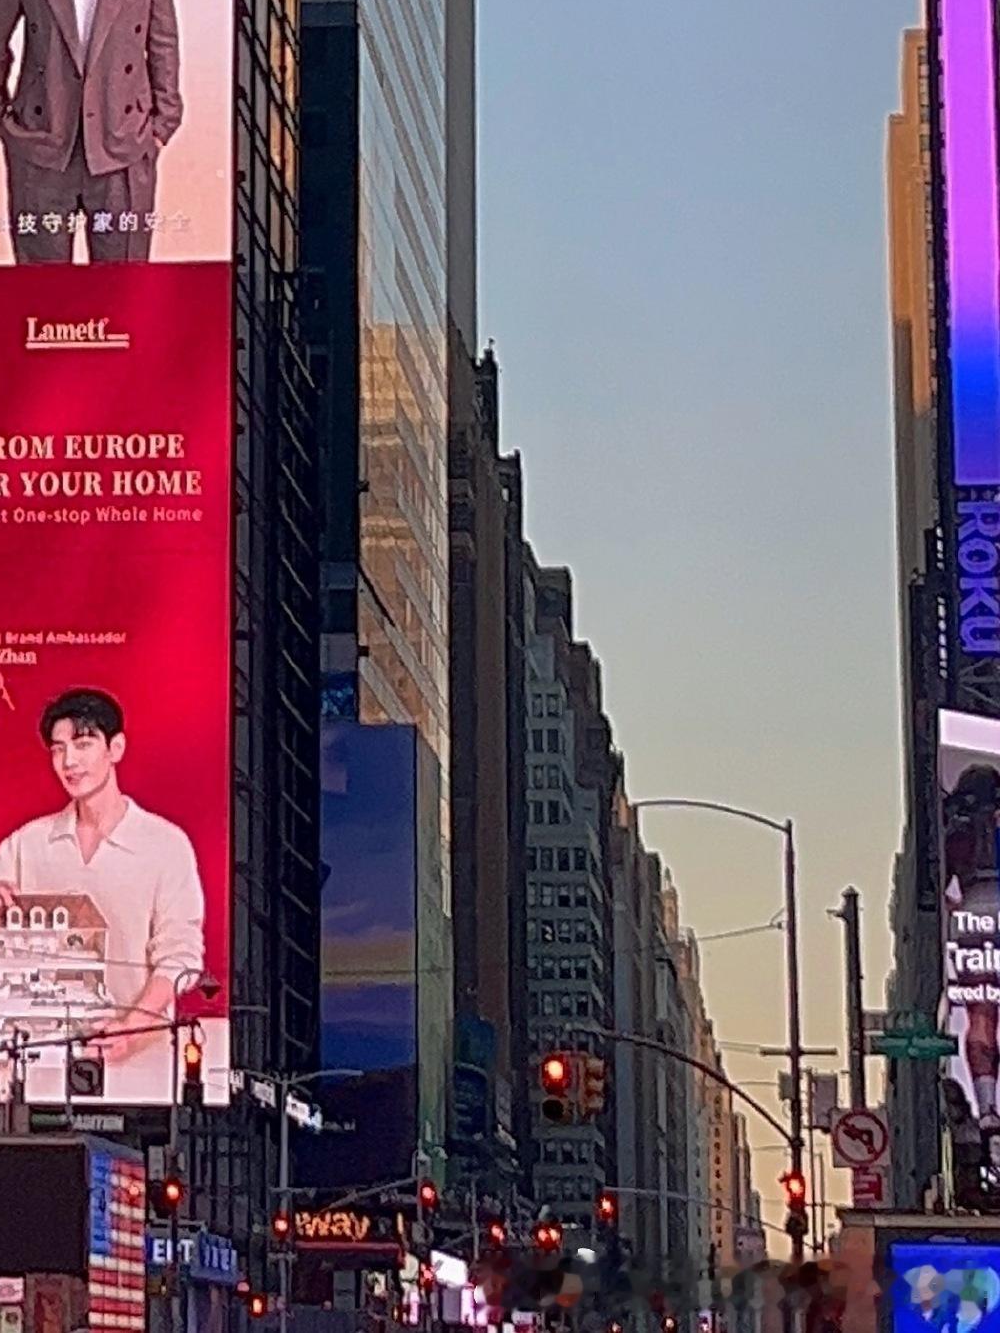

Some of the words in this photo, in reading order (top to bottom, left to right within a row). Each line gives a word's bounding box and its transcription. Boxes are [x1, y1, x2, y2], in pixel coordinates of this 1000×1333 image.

[26, 317, 109, 341] Lamett
[64, 434, 185, 459] EUROPE
[20, 470, 103, 497] YOUR
[112, 470, 202, 496] HOME
[13, 507, 90, 525] One-stop
[96, 506, 148, 522] Whole
[153, 506, 203, 521] Home
[957, 500, 1000, 653] ROKU
[5, 631, 43, 645] Brand
[952, 911, 995, 935] The
